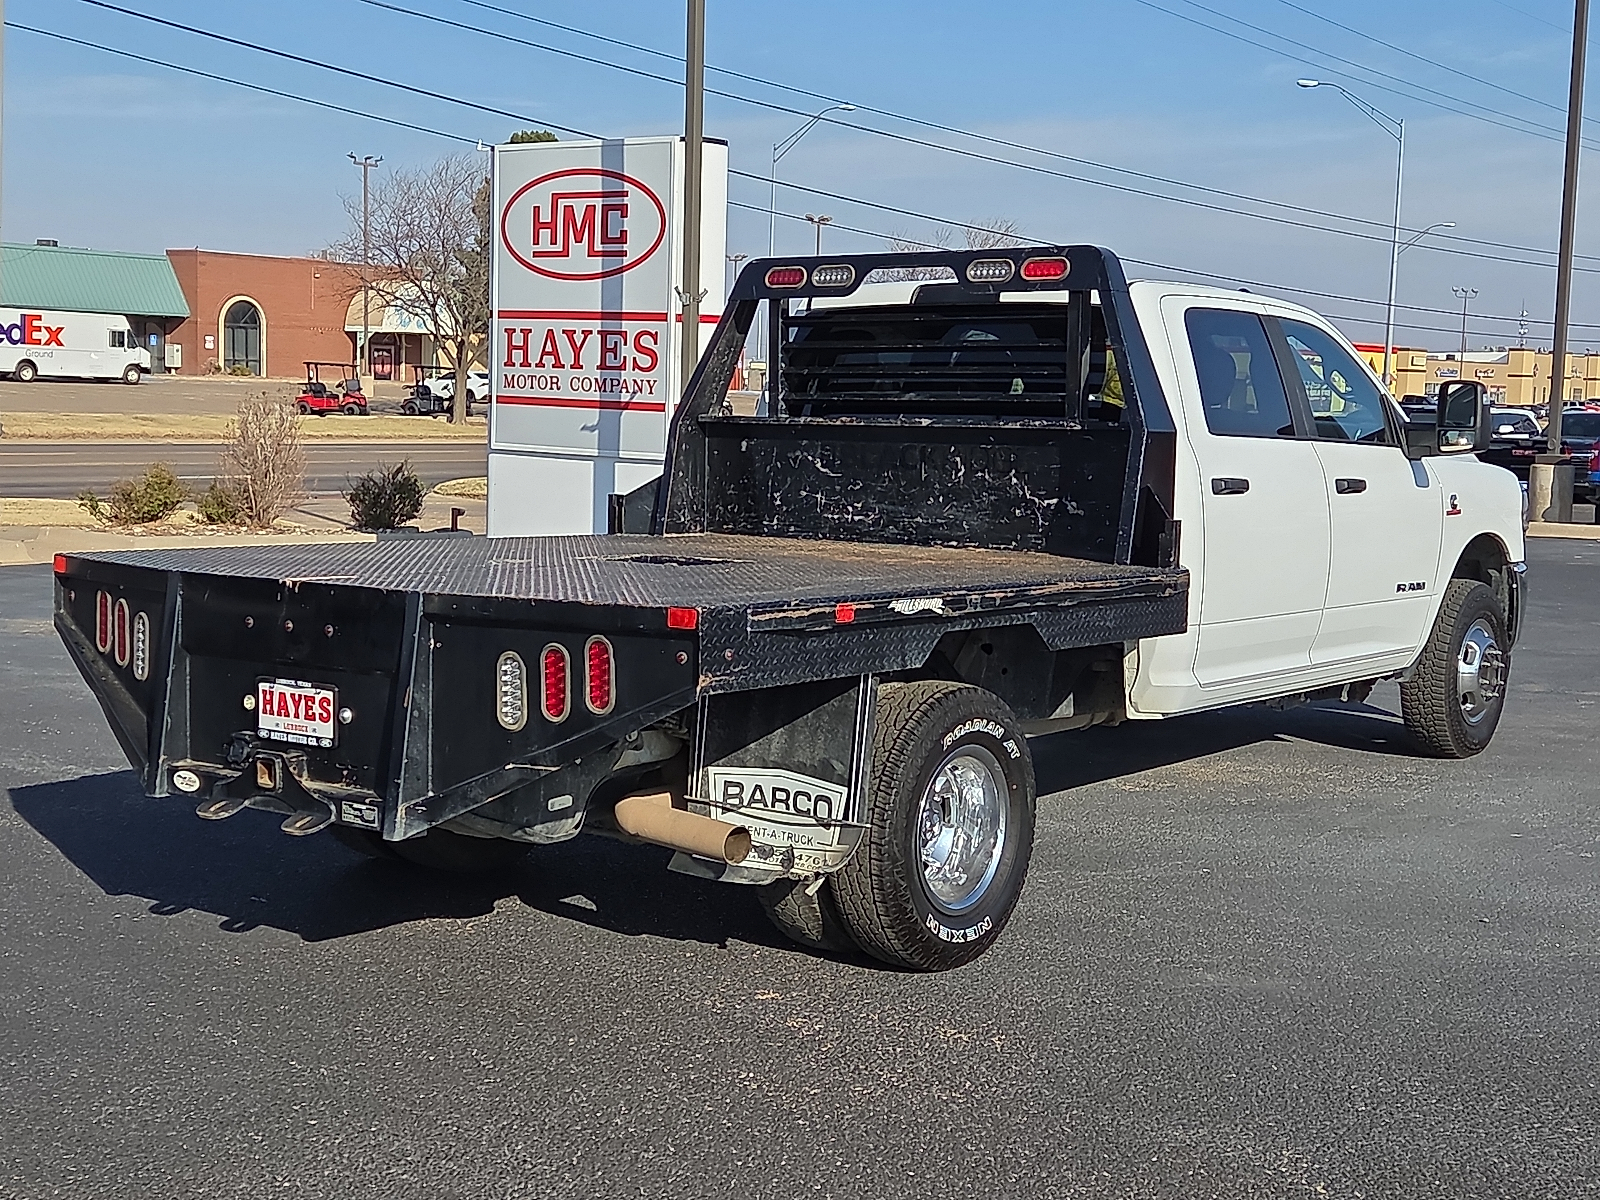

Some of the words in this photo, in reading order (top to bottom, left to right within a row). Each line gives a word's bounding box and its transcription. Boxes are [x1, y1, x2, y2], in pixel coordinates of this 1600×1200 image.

[532, 190, 629, 258] HMC
[25, 349, 54, 358] Ground
[503, 327, 659, 373] HAYES
[503, 373, 562, 391] MOTOR
[569, 376, 658, 395] COMPANY
[1396, 581, 1426, 593] RAM
[261, 689, 331, 723] HAYES
[942, 718, 1005, 752] ROADIAN
[1003, 739, 1021, 760] AT
[722, 780, 833, 824] BARCO
[925, 912, 993, 943] NEXEN
